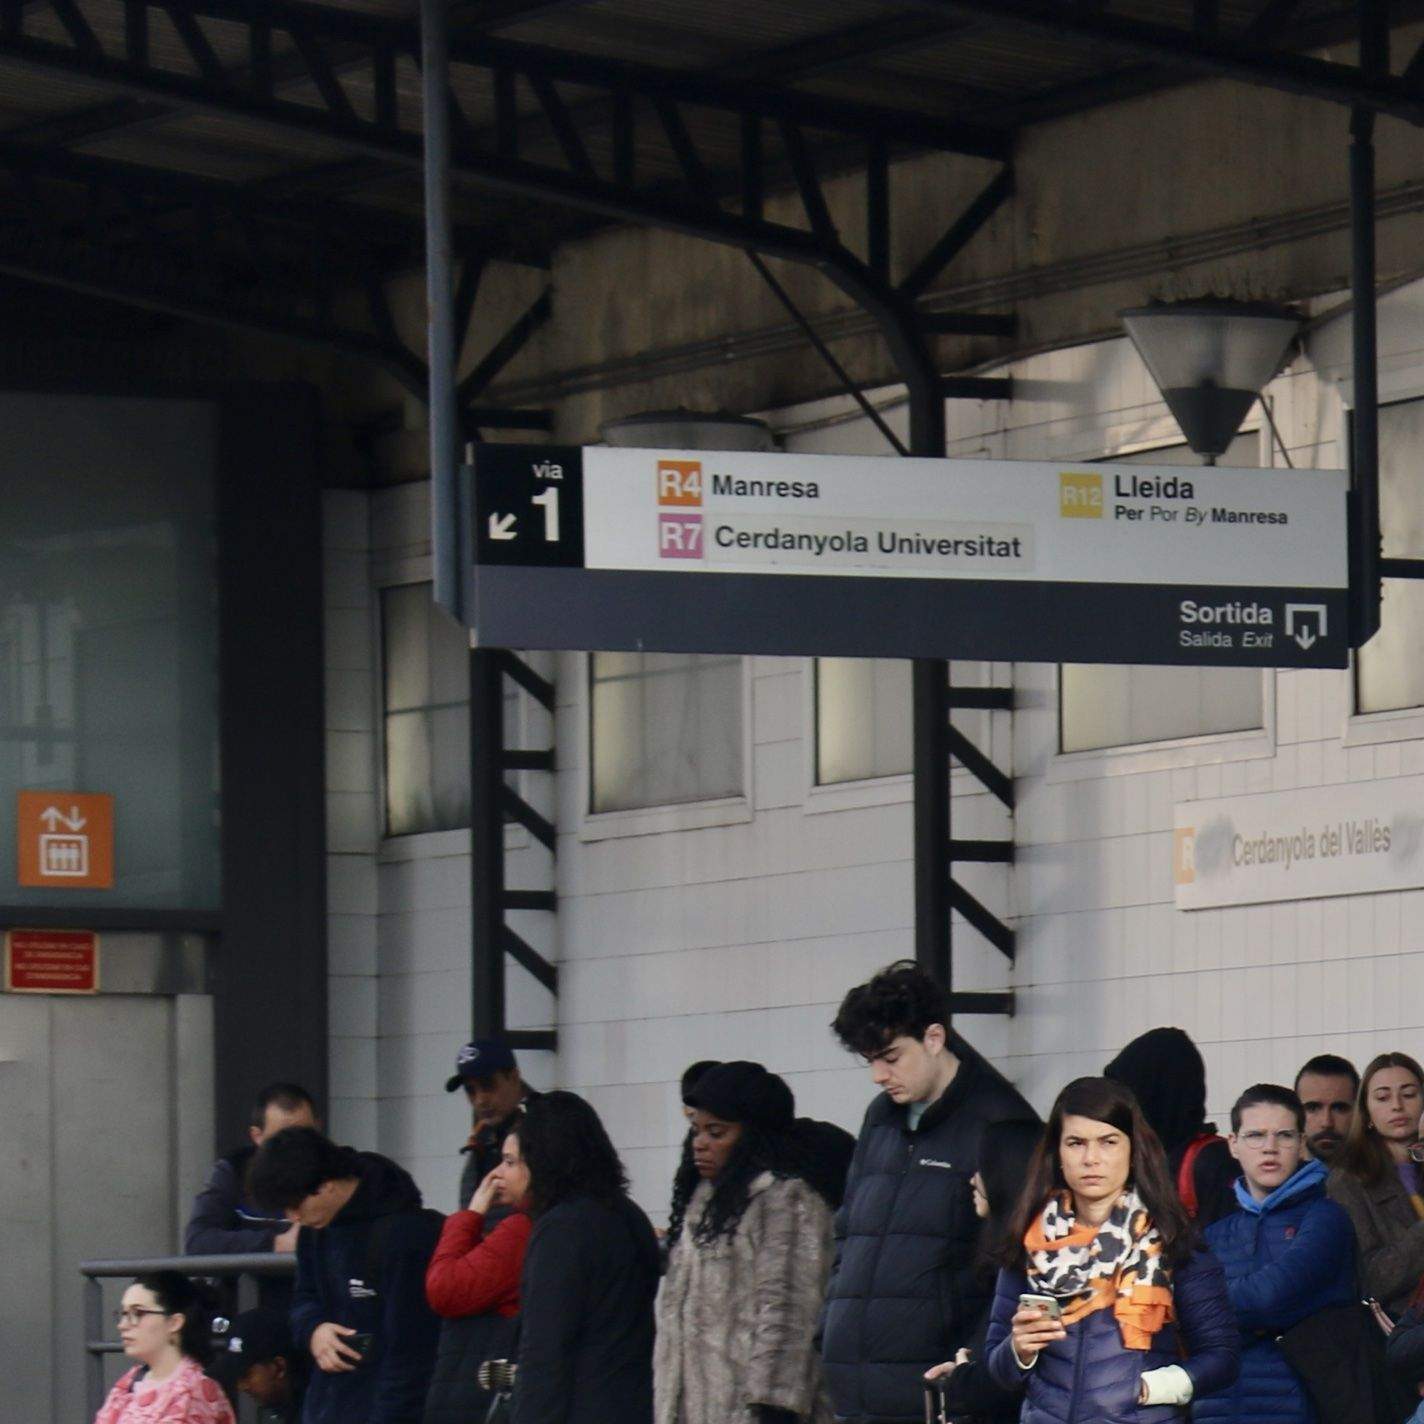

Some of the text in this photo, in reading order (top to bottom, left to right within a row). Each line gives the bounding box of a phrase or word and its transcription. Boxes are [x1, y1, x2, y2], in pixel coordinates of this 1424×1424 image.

[532, 460, 563, 479] via
[659, 469, 820, 501] R4 Manresa
[1062, 475, 1194, 507] R12 Lleida
[531, 486, 560, 541] 1
[1115, 505, 1288, 527] Per Por By Manresa
[660, 521, 1022, 558] R7 Cerdanyola Universitat
[1179, 600, 1273, 625] Sortida
[1179, 630, 1274, 648] Salida Exit
[1231, 818, 1392, 870] Cerdanyola del Vallès
